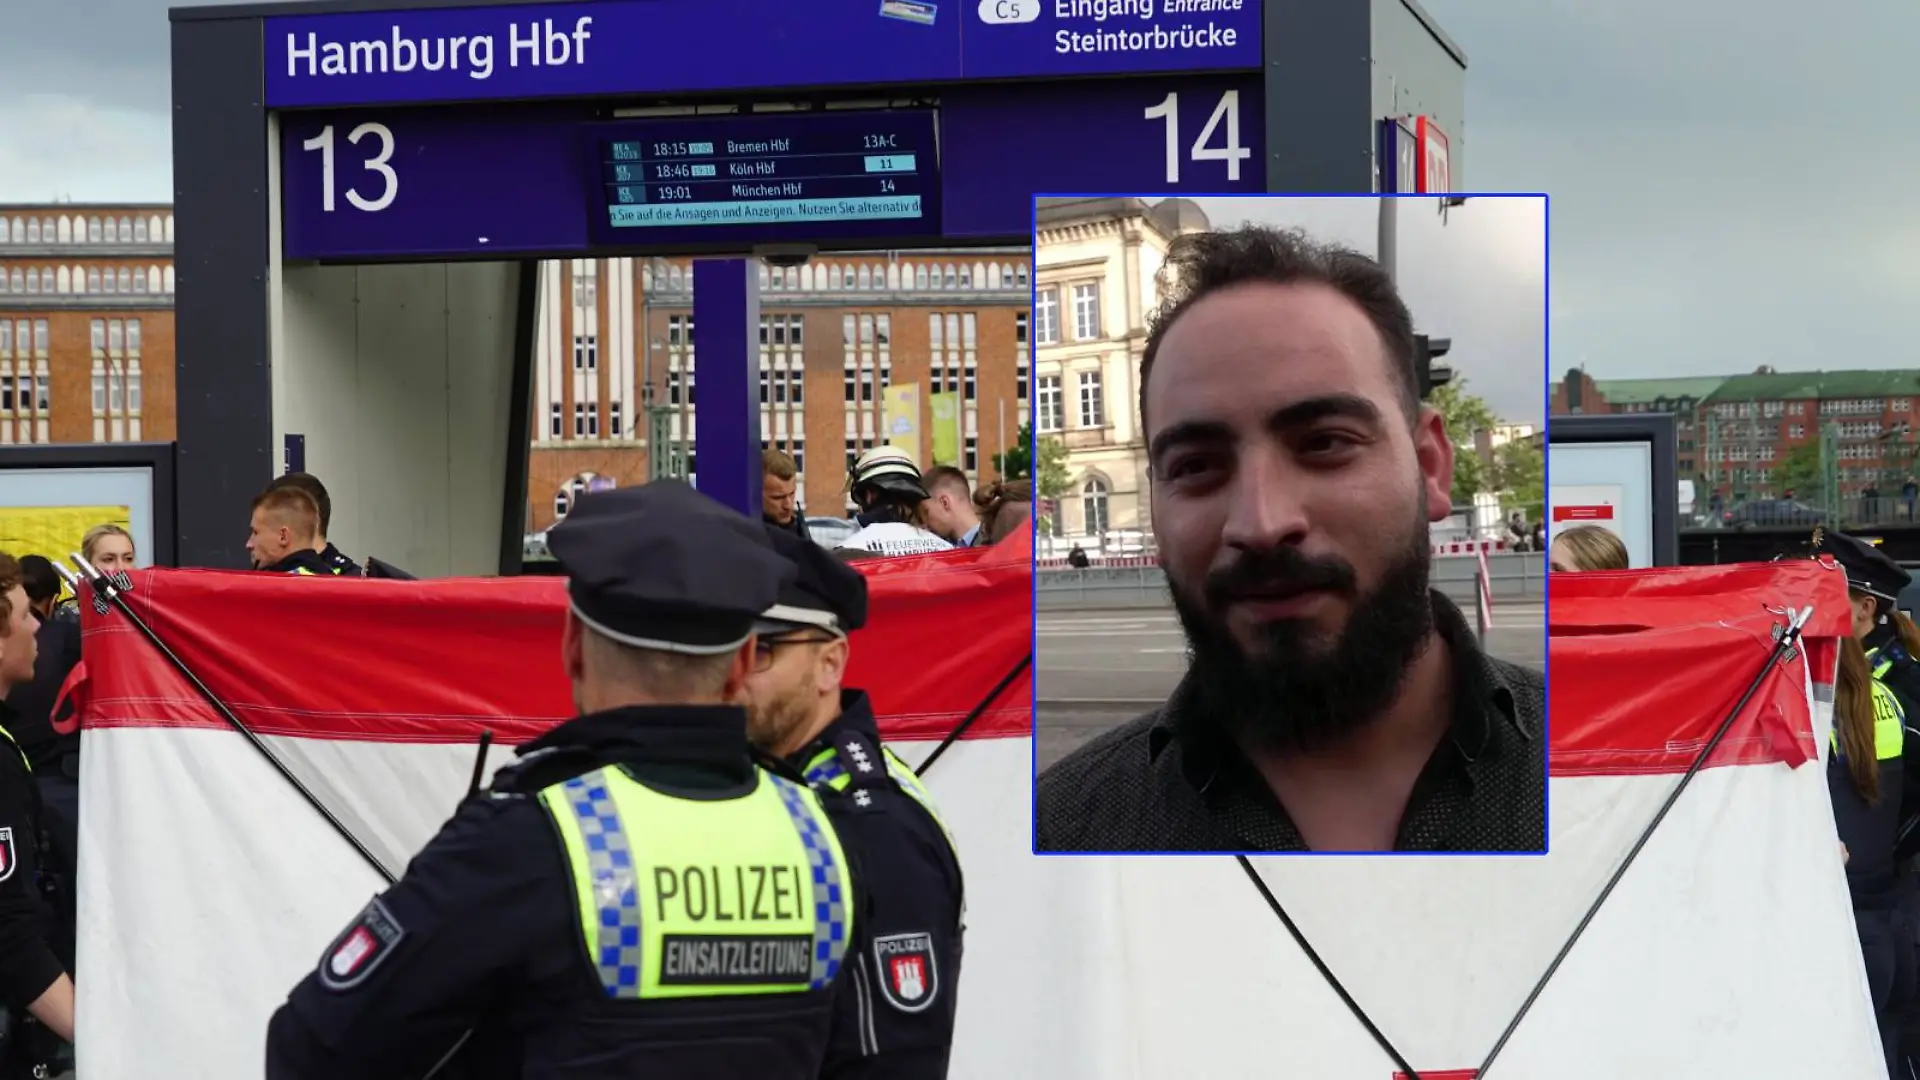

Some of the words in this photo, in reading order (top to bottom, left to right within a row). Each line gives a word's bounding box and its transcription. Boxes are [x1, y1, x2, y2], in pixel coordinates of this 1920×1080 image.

[1055, 0, 1153, 22] Eingang
[1163, 0, 1242, 13] Entrance
[1055, 22, 1237, 53] Steintorbrücke
[287, 25, 494, 79] Hamburg
[509, 16, 593, 67] Hbf
[863, 134, 897, 148] 13A-C
[1144, 90, 1251, 183] 14
[653, 142, 688, 156] 18:15
[727, 140, 768, 153] Bremen
[770, 138, 790, 152] Hbf
[303, 122, 399, 212] 13
[656, 164, 690, 178] 18:46
[729, 162, 754, 175] Köln
[756, 161, 776, 174] Hbf
[880, 159, 893, 169] 11
[658, 186, 692, 199] 19:01
[732, 184, 781, 197] München
[782, 183, 802, 196] Hbf
[880, 180, 895, 193] 14
[618, 208, 635, 221] Sie
[636, 208, 653, 220] auf
[656, 208, 672, 220] die
[674, 207, 720, 221] Ansagen
[721, 206, 741, 218] und
[744, 204, 795, 219] Anzeigen.
[797, 203, 837, 215] Nutzen
[838, 201, 855, 214] Sie
[857, 200, 909, 213] alternativ
[653, 865, 804, 922] POLIZEI
[878, 938, 930, 954] POLIZEI
[665, 939, 811, 976] EINSATZLEITUNG
